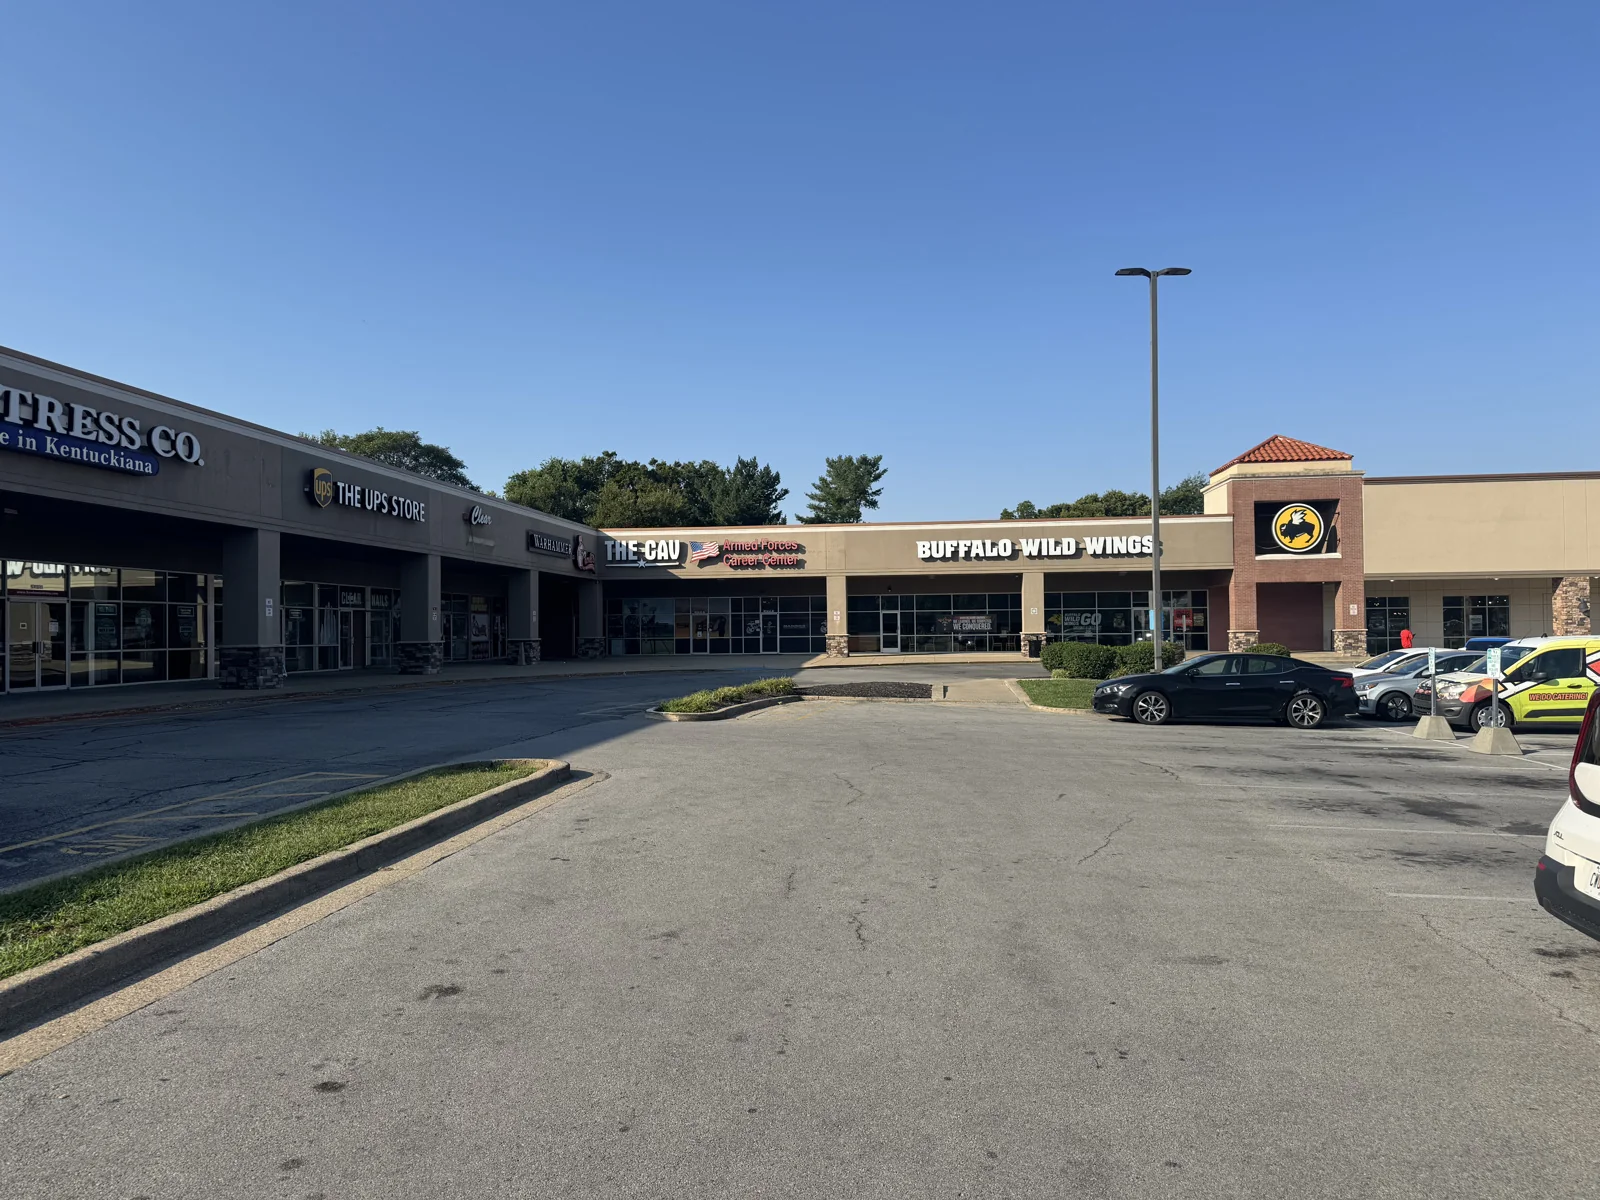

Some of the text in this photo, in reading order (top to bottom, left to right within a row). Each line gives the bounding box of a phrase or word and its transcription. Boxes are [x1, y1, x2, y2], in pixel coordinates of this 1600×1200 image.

[17, 429, 37, 451] in
[44, 435, 153, 474] Kentuckiana
[151, 425, 205, 467] CO.
[315, 479, 332, 502] ups
[337, 481, 425, 522] THE UPS STORE
[533, 533, 573, 556] WARHAMMER
[604, 539, 680, 560] THE CAV
[723, 538, 798, 551] Armed Forces
[916, 535, 1154, 558] BUFFALO WILD WINGS
[723, 553, 798, 567] Career Center
[371, 594, 388, 606] NAILS
[1080, 613, 1102, 625] GO
[1529, 692, 1588, 701] WE DO CATERING!
